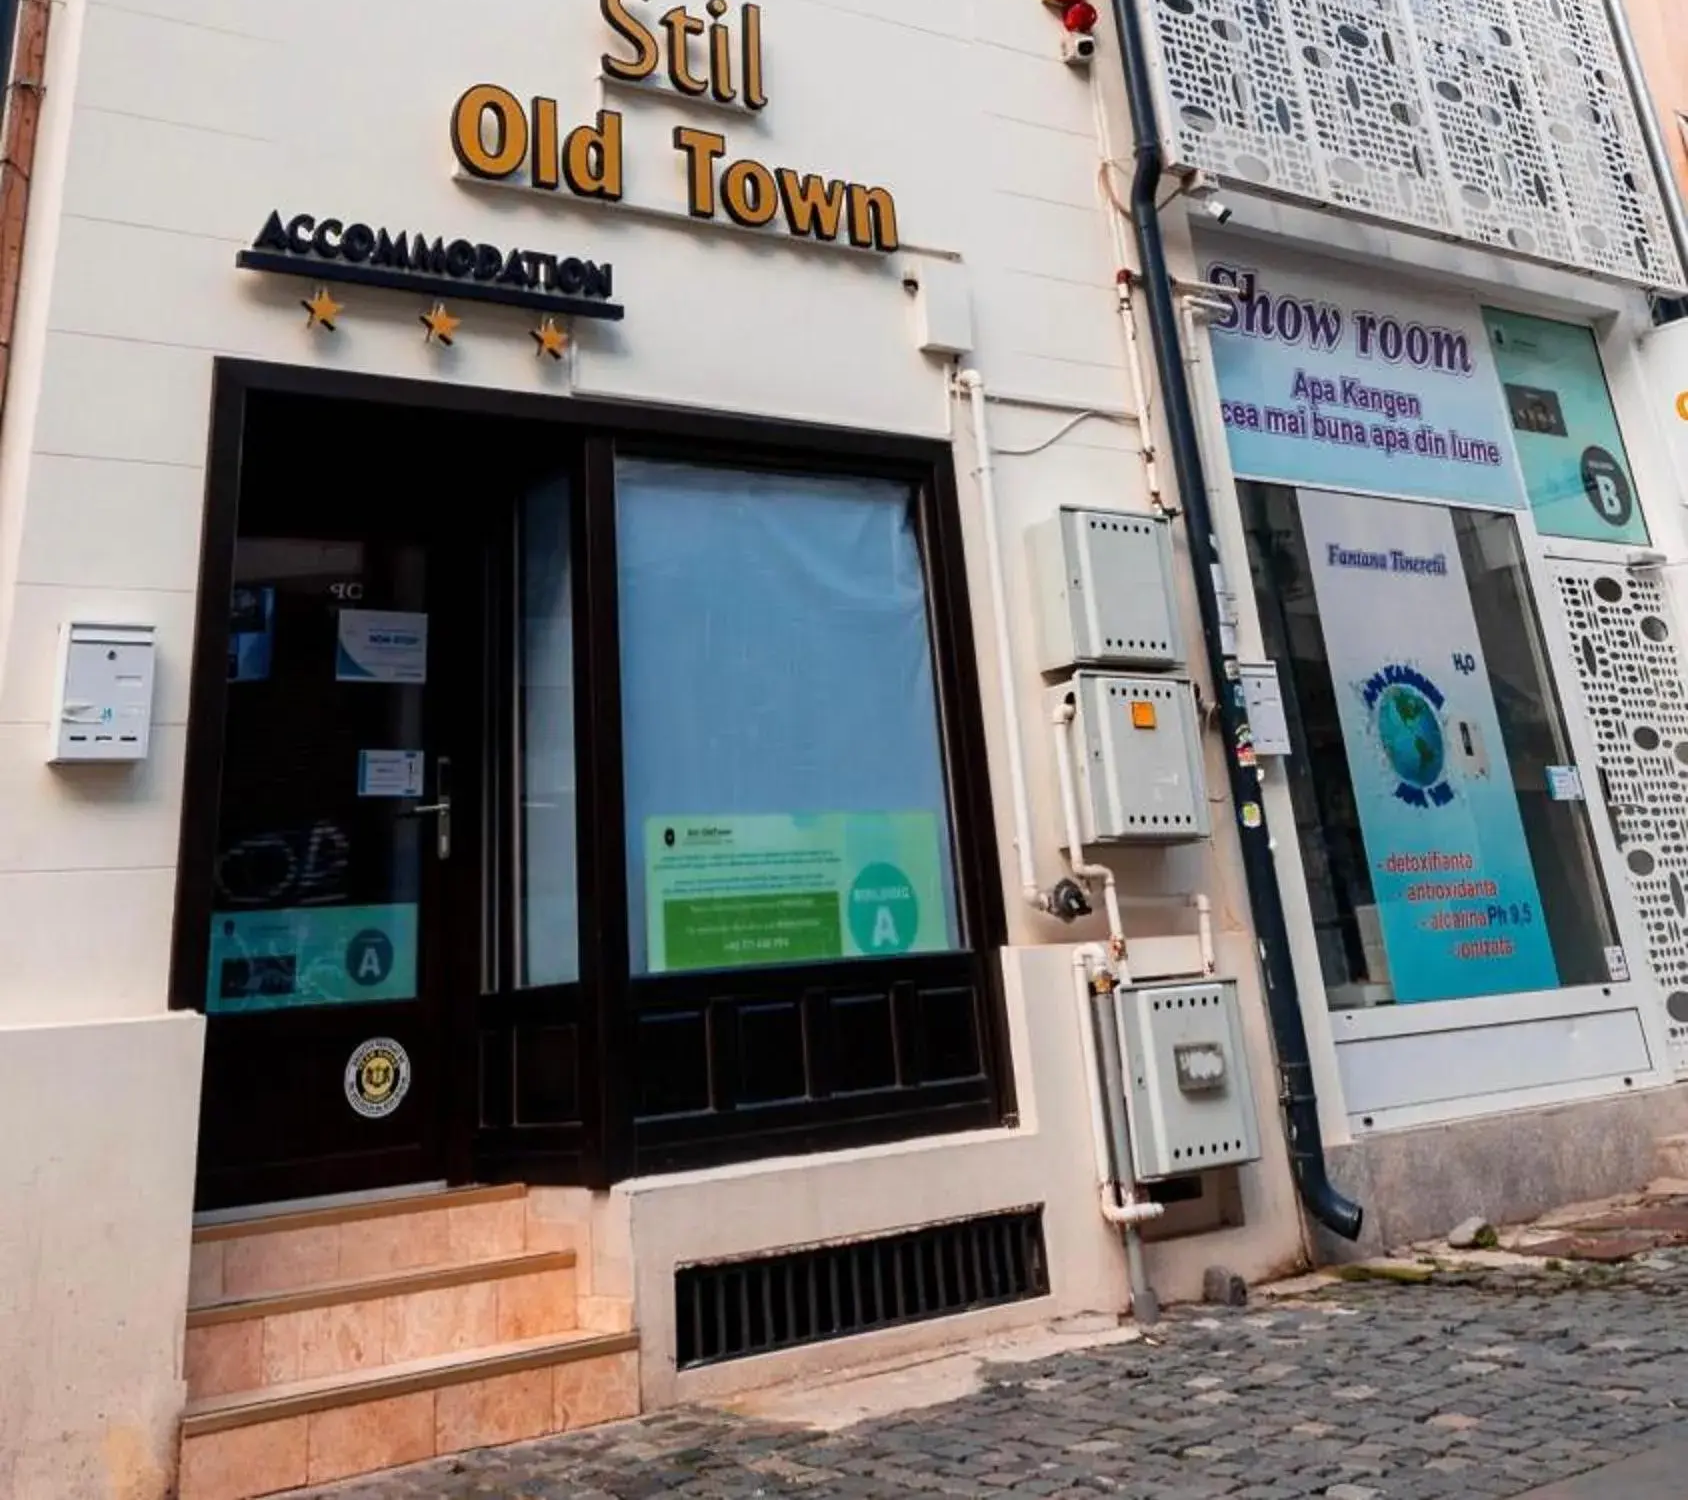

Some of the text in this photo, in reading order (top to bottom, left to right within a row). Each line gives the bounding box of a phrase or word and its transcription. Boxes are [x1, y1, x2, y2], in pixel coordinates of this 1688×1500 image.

[450, 83, 900, 251] Old Town
[253, 209, 612, 298] ACCOMMODATION
[1208, 263, 1474, 376] Show room
[1291, 370, 1421, 421] Apa Kangen
[1221, 400, 1501, 466] cea mai buna apa din lume
[1596, 474, 1622, 516] B
[873, 904, 900, 948] A
[358, 946, 381, 977] A
